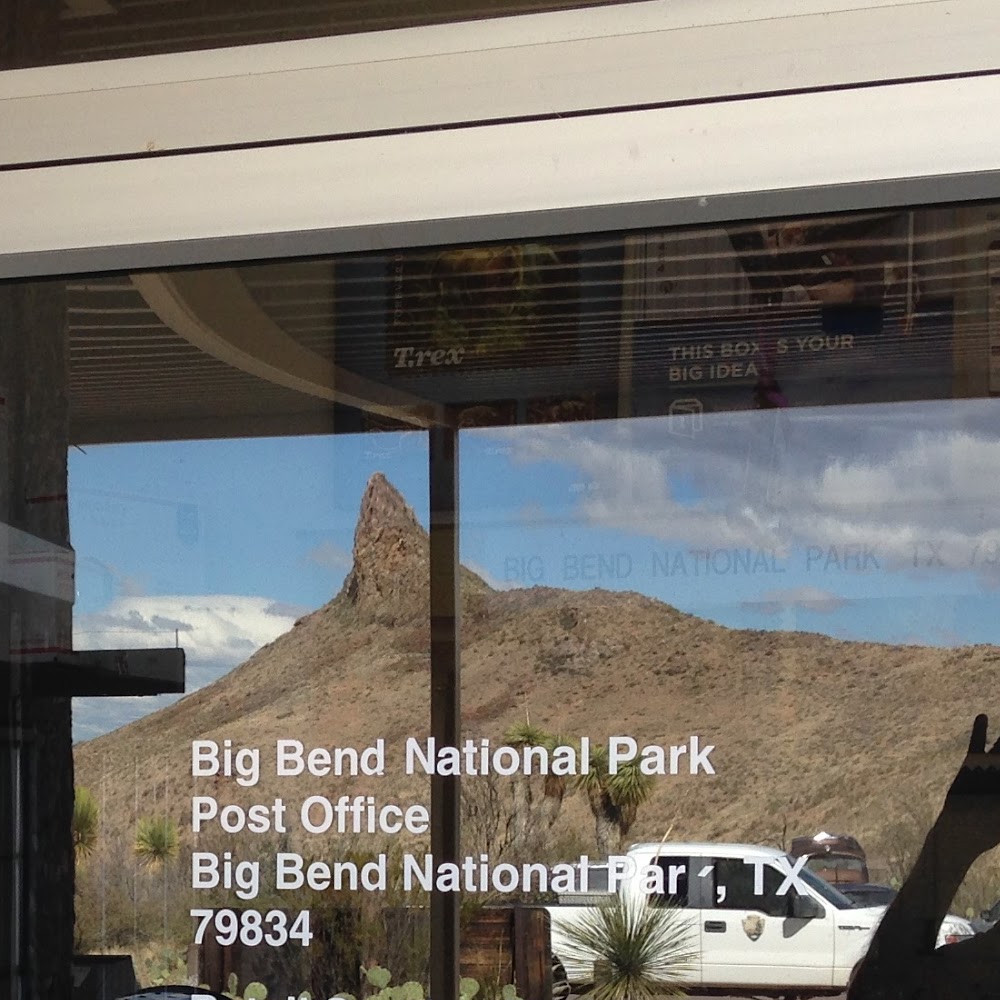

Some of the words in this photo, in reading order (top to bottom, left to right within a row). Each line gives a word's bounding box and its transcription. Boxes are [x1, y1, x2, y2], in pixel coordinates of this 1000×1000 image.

[669, 346, 713, 361] THIS
[797, 335, 856, 351] YOUR
[669, 367, 703, 382] BIG
[710, 363, 759, 380] IDEA
[191, 740, 260, 786] Big
[276, 738, 386, 777] Bend
[405, 737, 589, 777] National
[609, 735, 715, 776] Park
[191, 798, 286, 835] Post
[301, 795, 430, 834] Office
[191, 852, 260, 899] Big
[277, 852, 387, 892] Bend
[402, 853, 588, 893] National
[608, 855, 726, 903] Par,
[743, 855, 809, 896] TX
[191, 909, 312, 947] 79834
